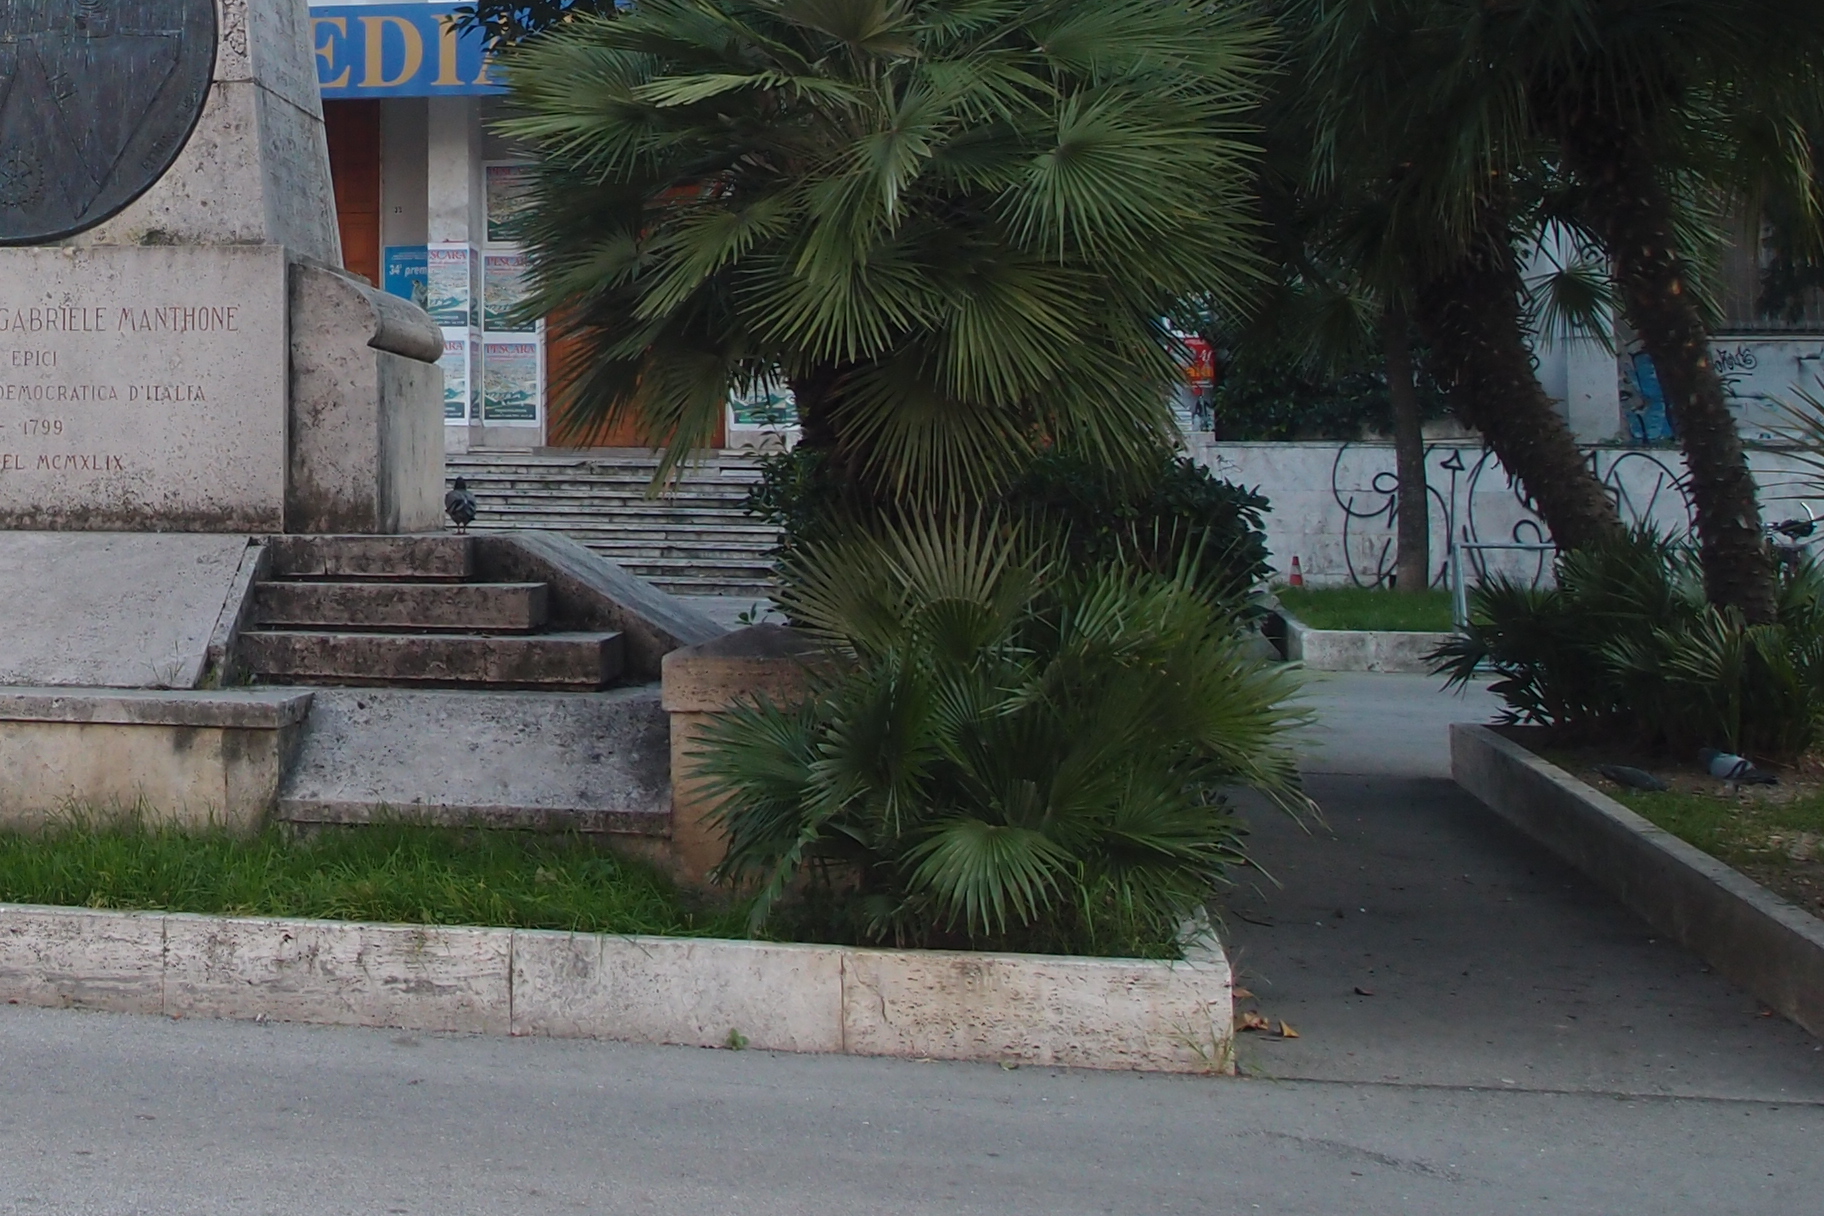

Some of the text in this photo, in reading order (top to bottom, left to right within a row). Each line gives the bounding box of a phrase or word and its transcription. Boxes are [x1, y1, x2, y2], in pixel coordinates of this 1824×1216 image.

[486, 344, 535, 354] PESCARA
[12, 350, 57, 366] EPICI
[128, 385, 207, 401] D'ITALIA
[24, 419, 63, 435] 1799
[37, 454, 124, 471] MCMXLIX
